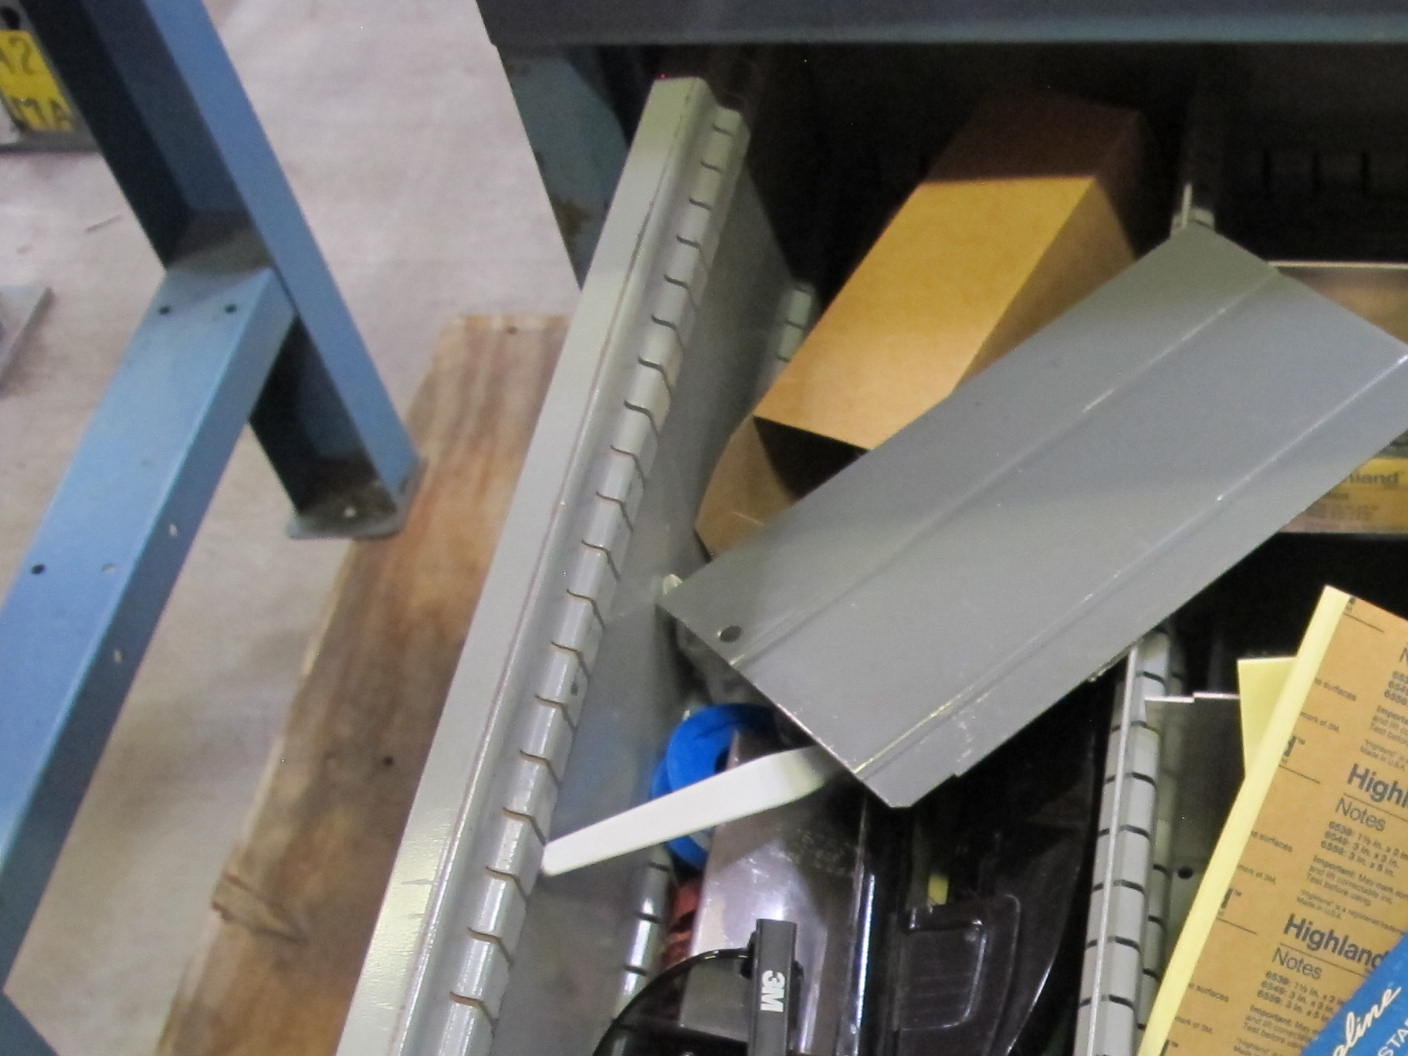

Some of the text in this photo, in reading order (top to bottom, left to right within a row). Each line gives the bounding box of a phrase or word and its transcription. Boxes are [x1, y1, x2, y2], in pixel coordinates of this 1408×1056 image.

[1335, 798, 1387, 832] Notes
[1272, 946, 1323, 980] Notes
[760, 969, 785, 1013] 3M
